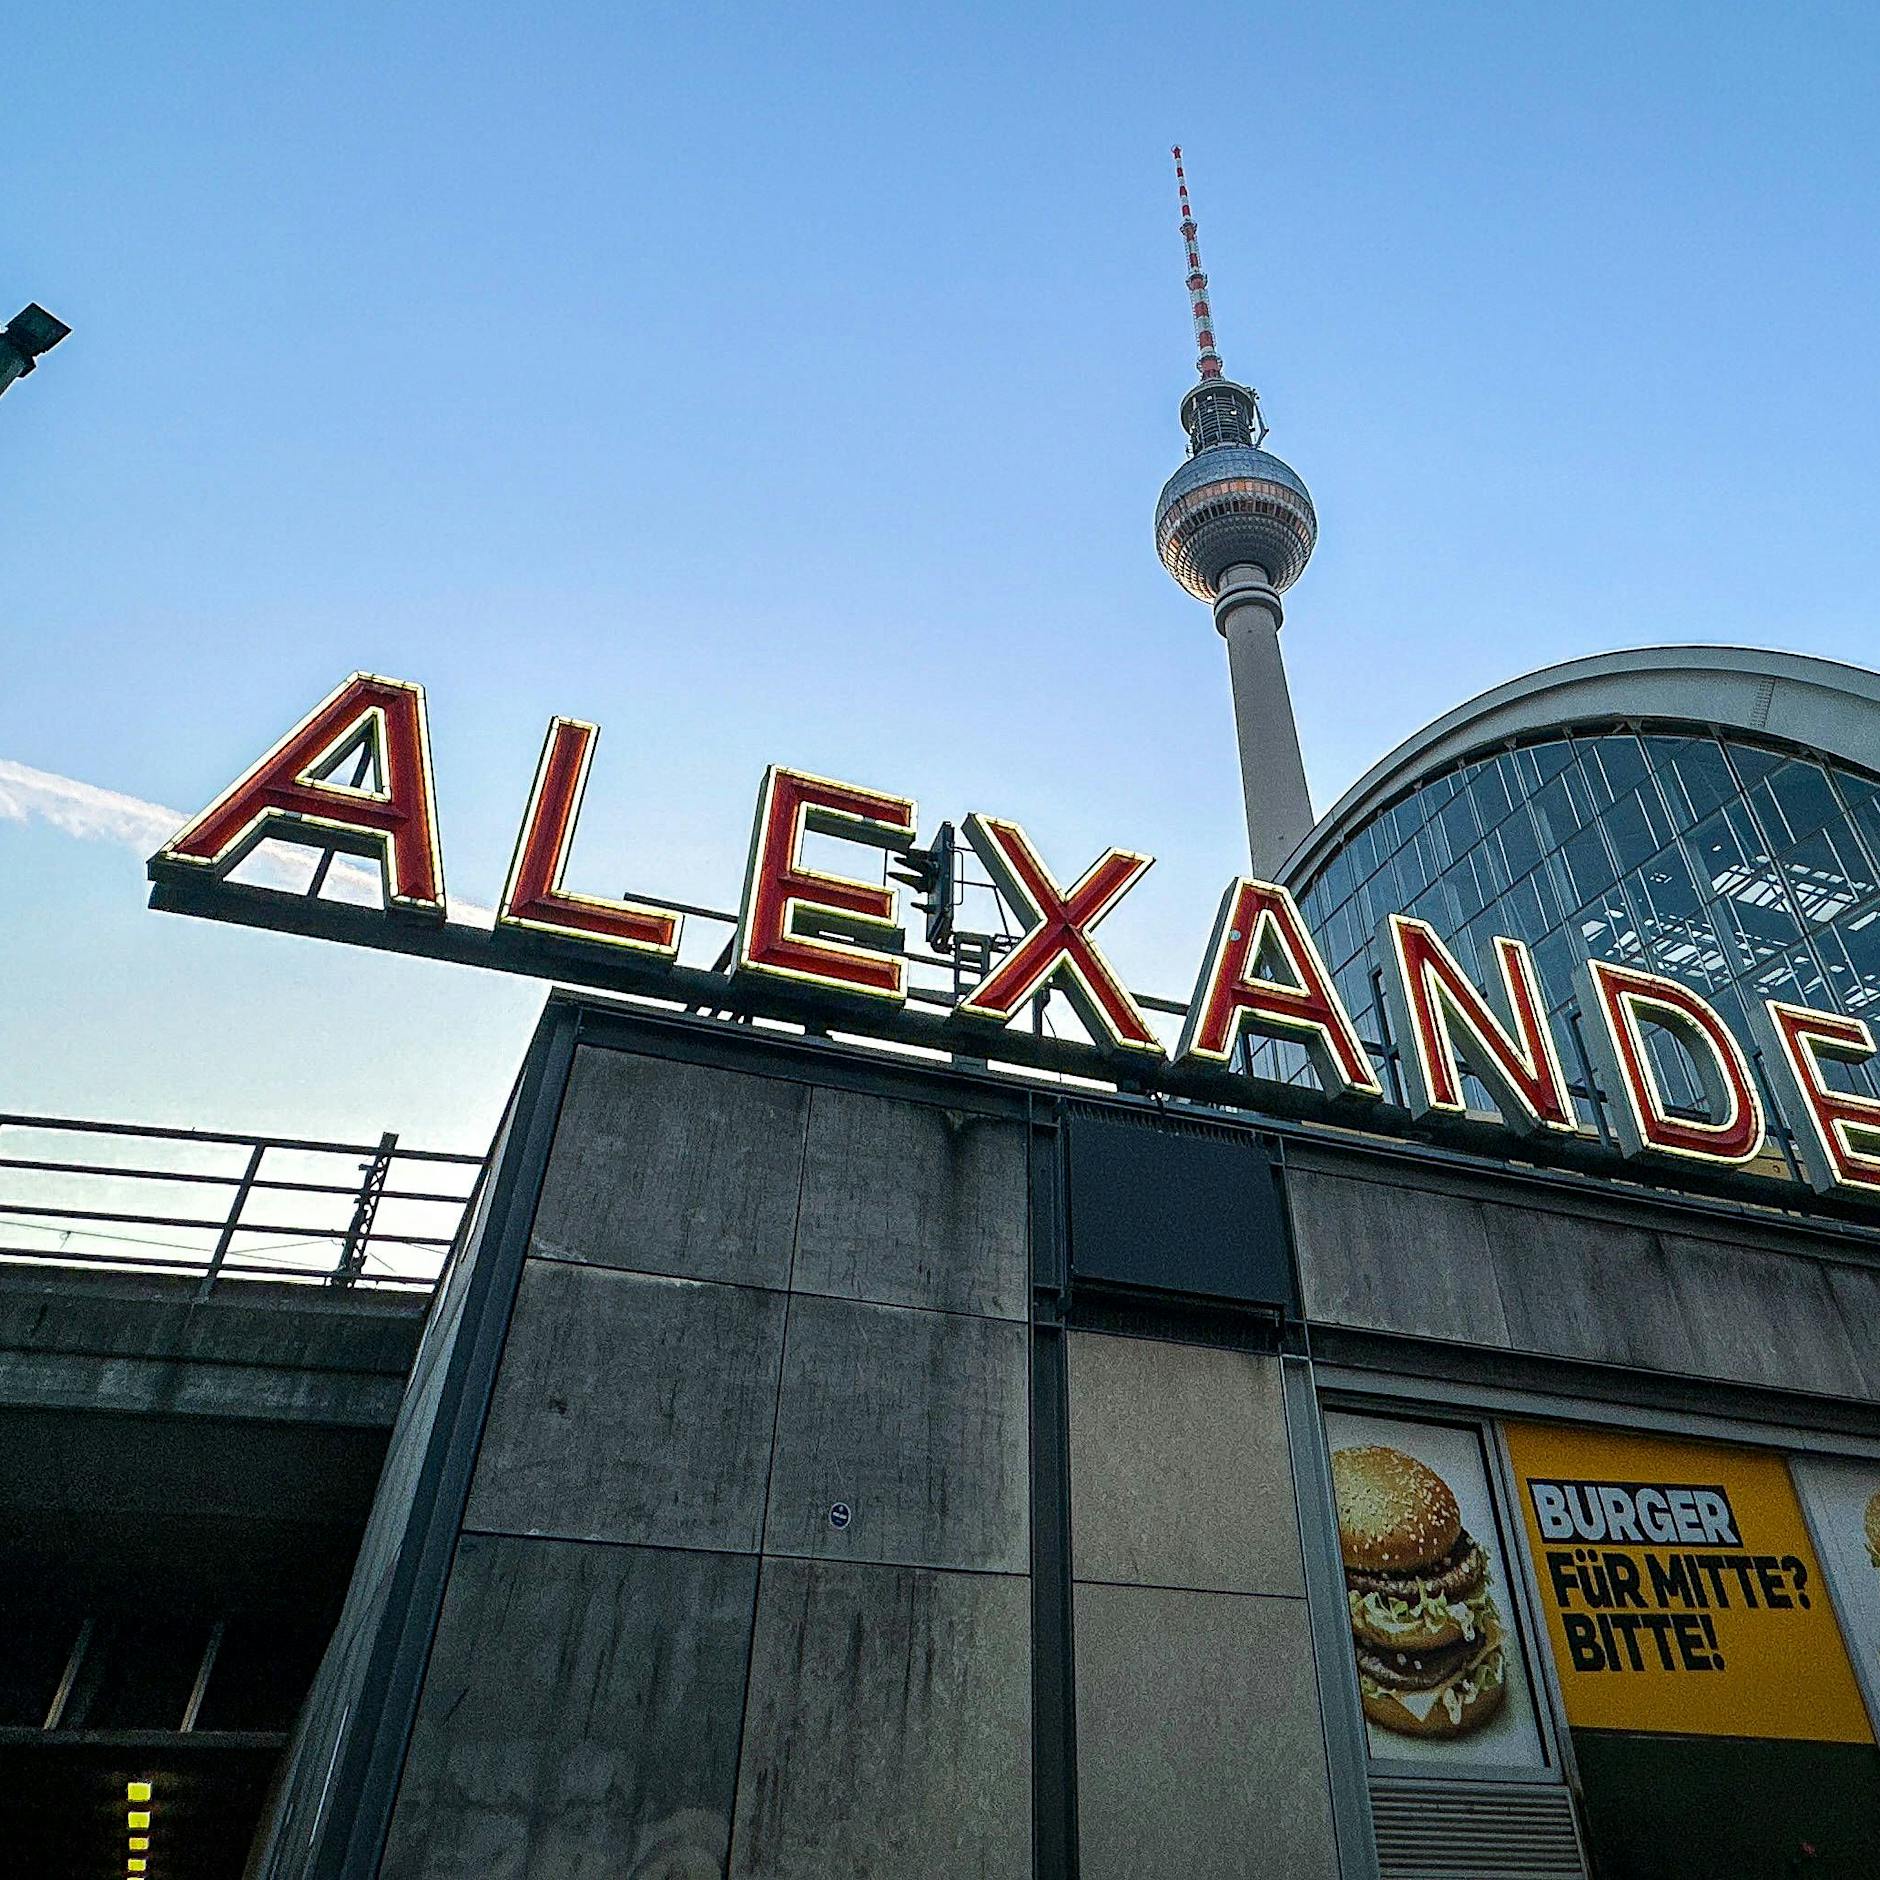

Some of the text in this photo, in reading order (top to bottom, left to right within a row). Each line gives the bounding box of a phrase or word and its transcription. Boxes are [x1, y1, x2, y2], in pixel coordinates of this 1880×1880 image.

[149, 669, 1880, 1192] ALEXANDE
[1532, 1484, 1738, 1543] BURGER
[1644, 1553, 1810, 1610] MITTE?
[1562, 1613, 1725, 1671] BITTE!
